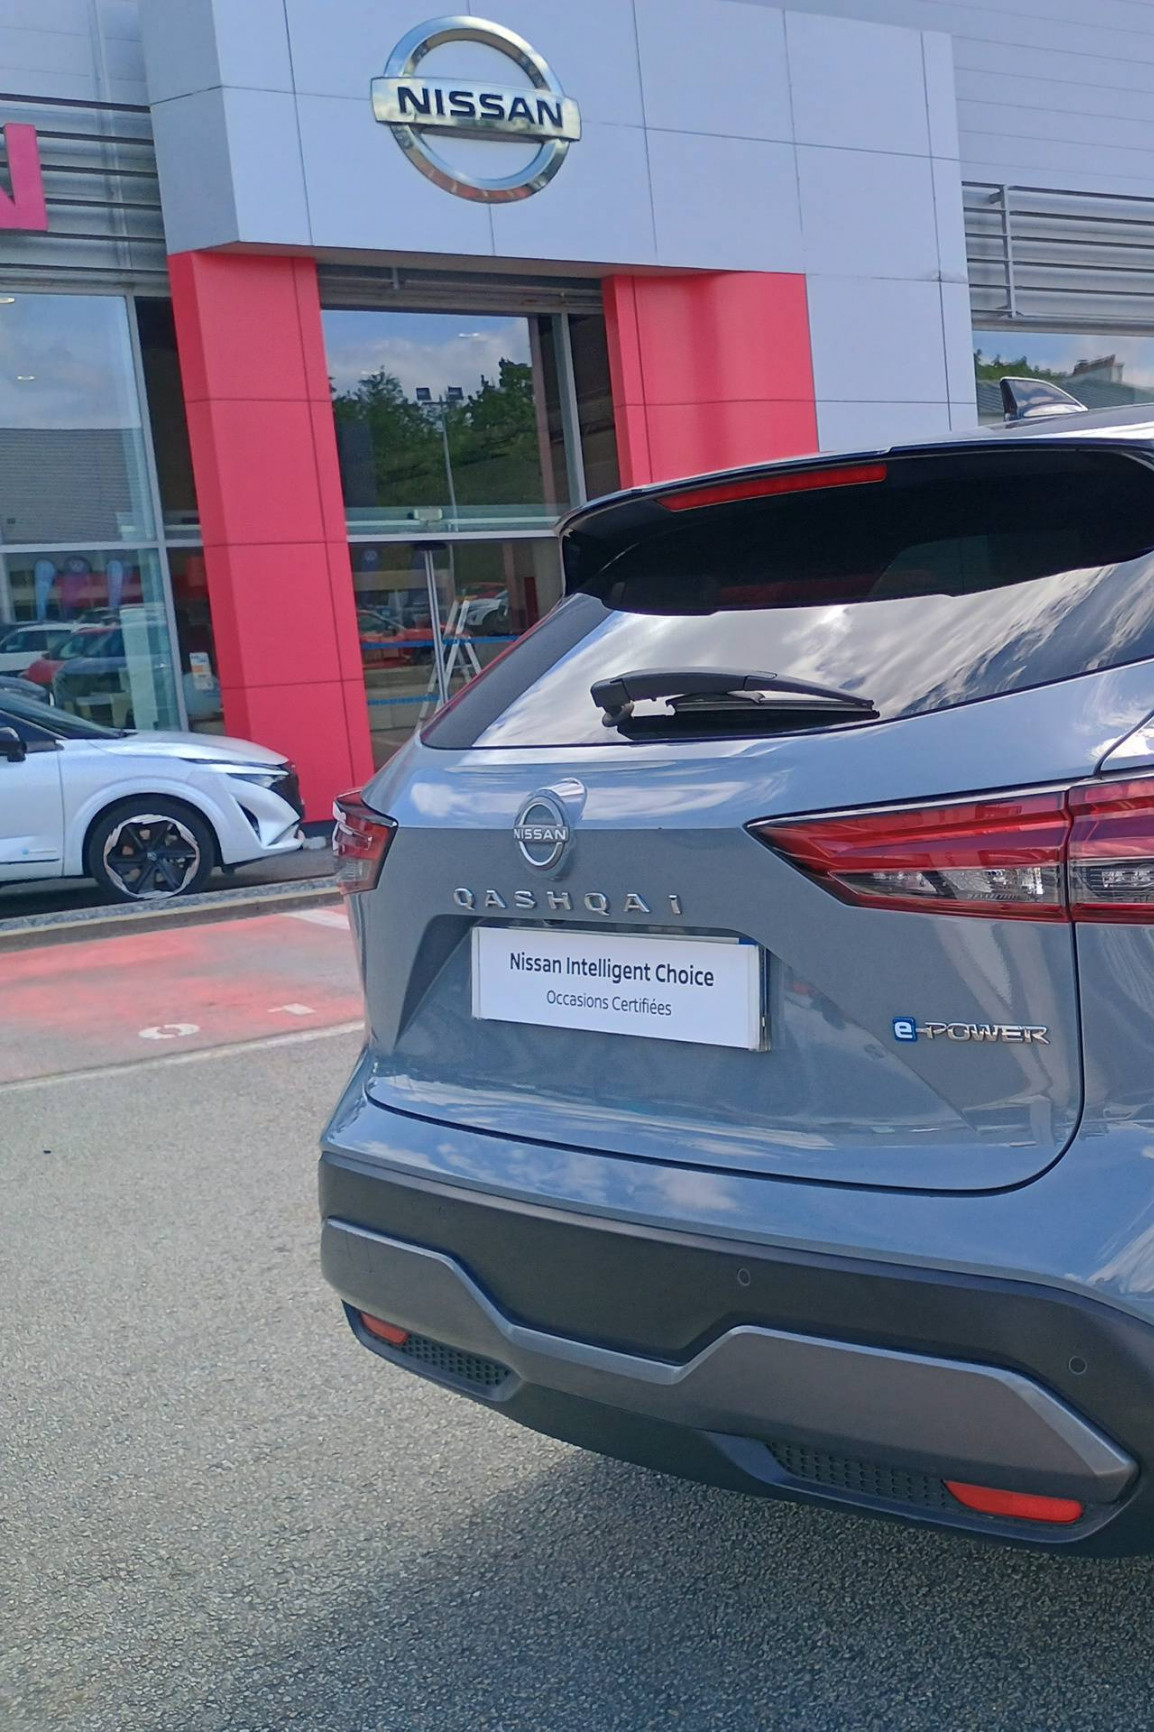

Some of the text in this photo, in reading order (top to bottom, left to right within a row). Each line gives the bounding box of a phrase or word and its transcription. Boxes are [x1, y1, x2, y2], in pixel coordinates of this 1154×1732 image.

[397, 87, 563, 128] NISSAN
[514, 828, 567, 842] NISSAN
[509, 952, 715, 987] Nissan Intelligent Choice
[546, 990, 672, 1016] Occasions Certifiées
